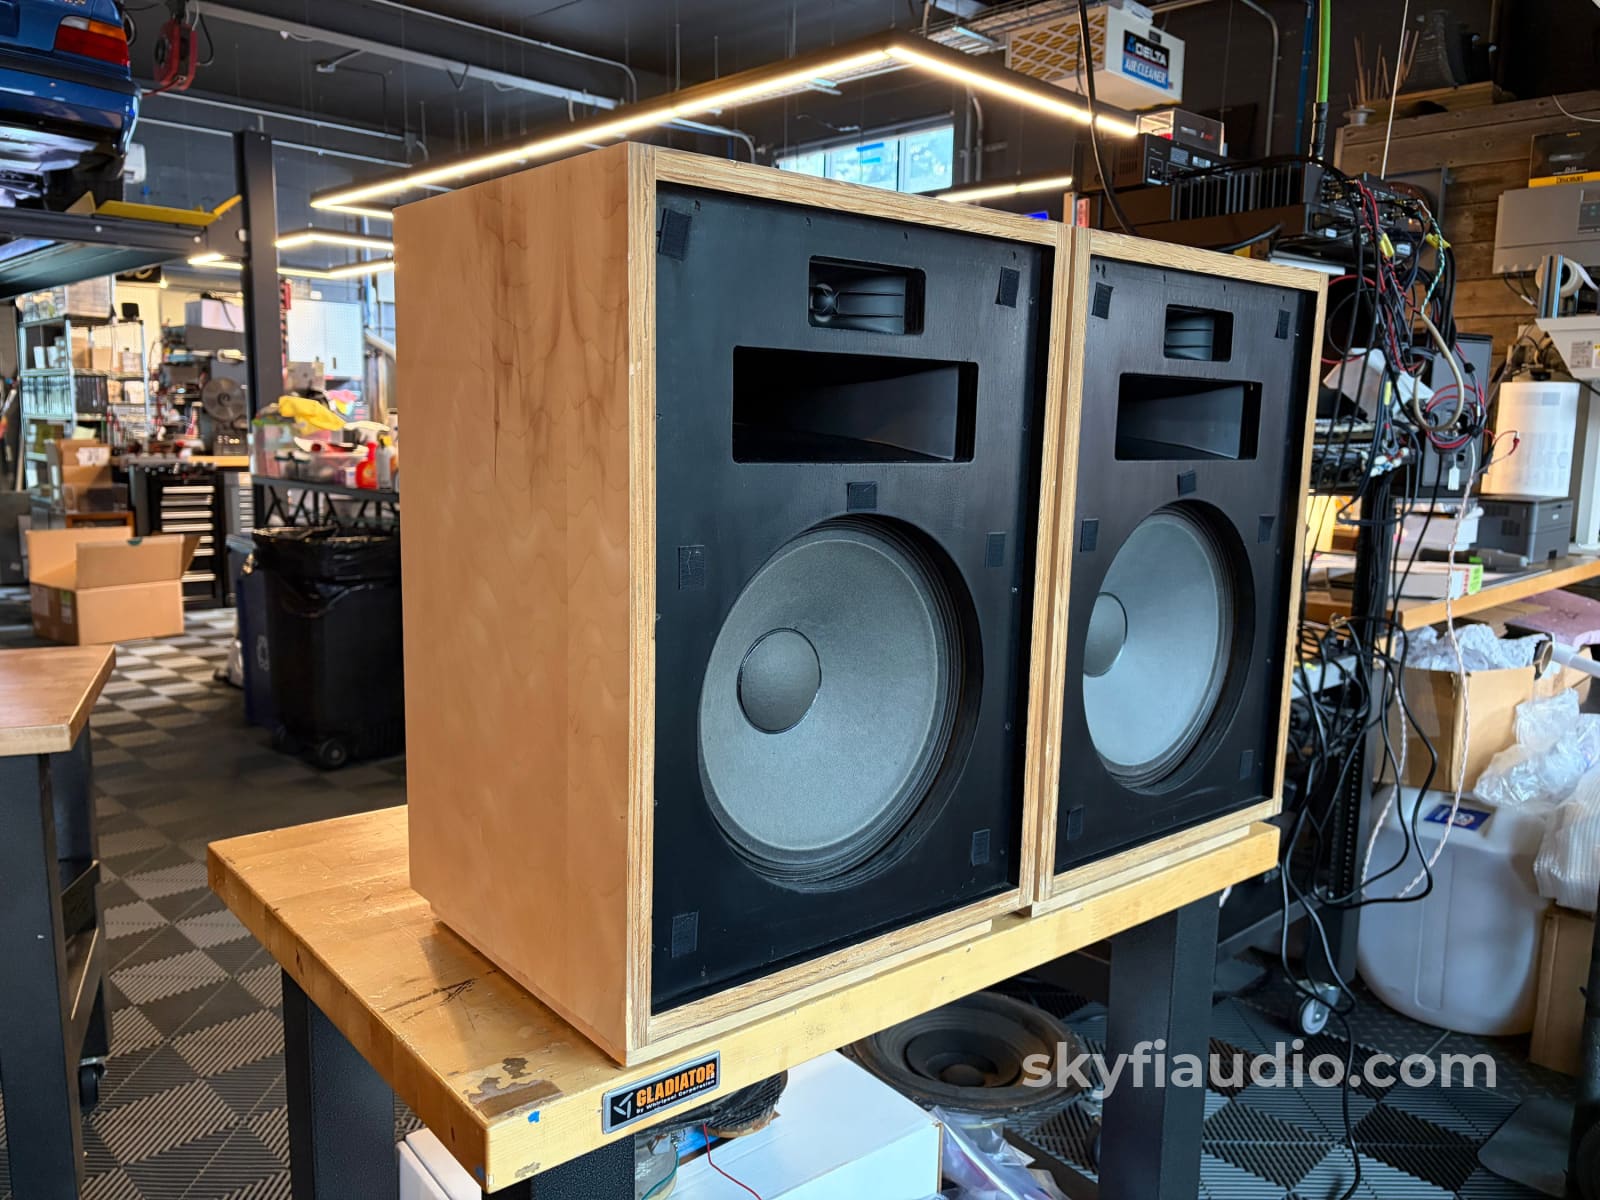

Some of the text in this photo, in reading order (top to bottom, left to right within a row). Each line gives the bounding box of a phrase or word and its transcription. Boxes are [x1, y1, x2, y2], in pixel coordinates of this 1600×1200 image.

[1135, 42, 1167, 66] DELTA
[1125, 58, 1167, 85] AIR CLEANER
[636, 1063, 715, 1107] GLADIATOR
[646, 1094, 677, 1109] Whirlpool
[678, 1080, 715, 1096] Corporation
